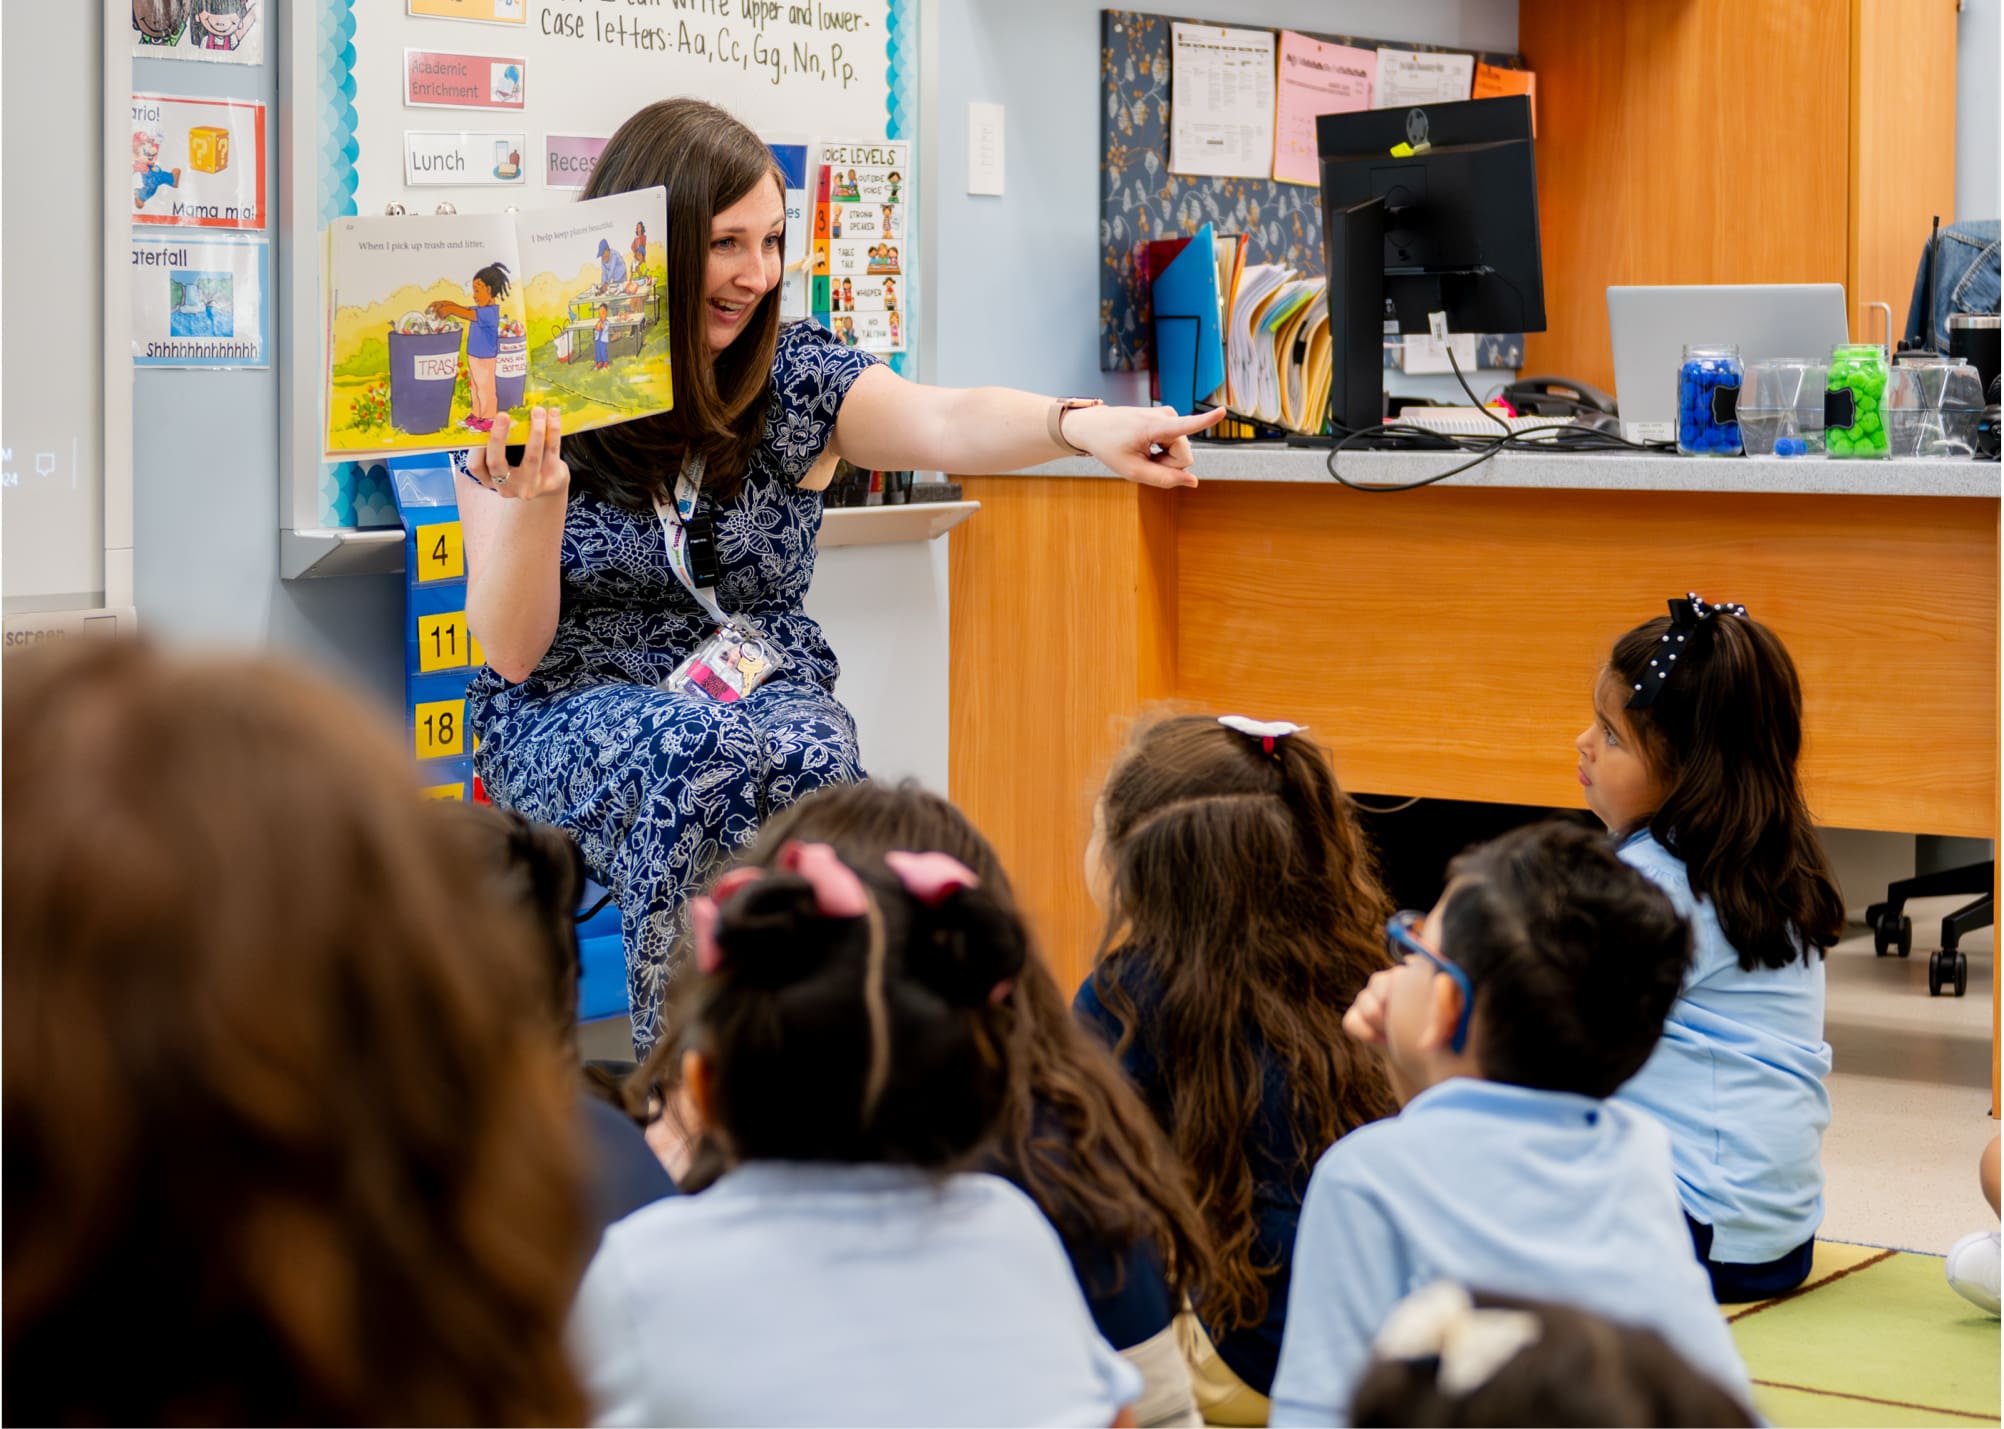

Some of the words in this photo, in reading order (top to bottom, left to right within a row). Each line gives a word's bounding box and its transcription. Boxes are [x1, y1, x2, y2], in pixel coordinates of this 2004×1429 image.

[742, 0, 784, 31] upper
[789, 0, 812, 27] and
[595, 11, 673, 51] letters:
[678, 20, 713, 63] Aa,
[718, 27, 748, 70] Cc,
[753, 33, 788, 85] Gg,
[793, 42, 825, 81] Nn,
[831, 43, 859, 89] Pp.
[412, 60, 468, 77] Academic
[412, 81, 480, 99] Enrichment
[412, 149, 465, 171] Lunch
[823, 147, 847, 163] OICE
[850, 148, 896, 165] LEVELS
[863, 186, 882, 195] VOICE
[172, 201, 218, 218] Mama
[225, 205, 255, 220] mia!
[818, 210, 826, 232] 3
[359, 241, 384, 251] When
[391, 241, 409, 252] pick
[411, 243, 423, 252] up
[424, 241, 446, 250] trash
[447, 240, 463, 249] and
[432, 534, 449, 566] 4
[430, 623, 456, 658] 11
[423, 712, 455, 746] 18
